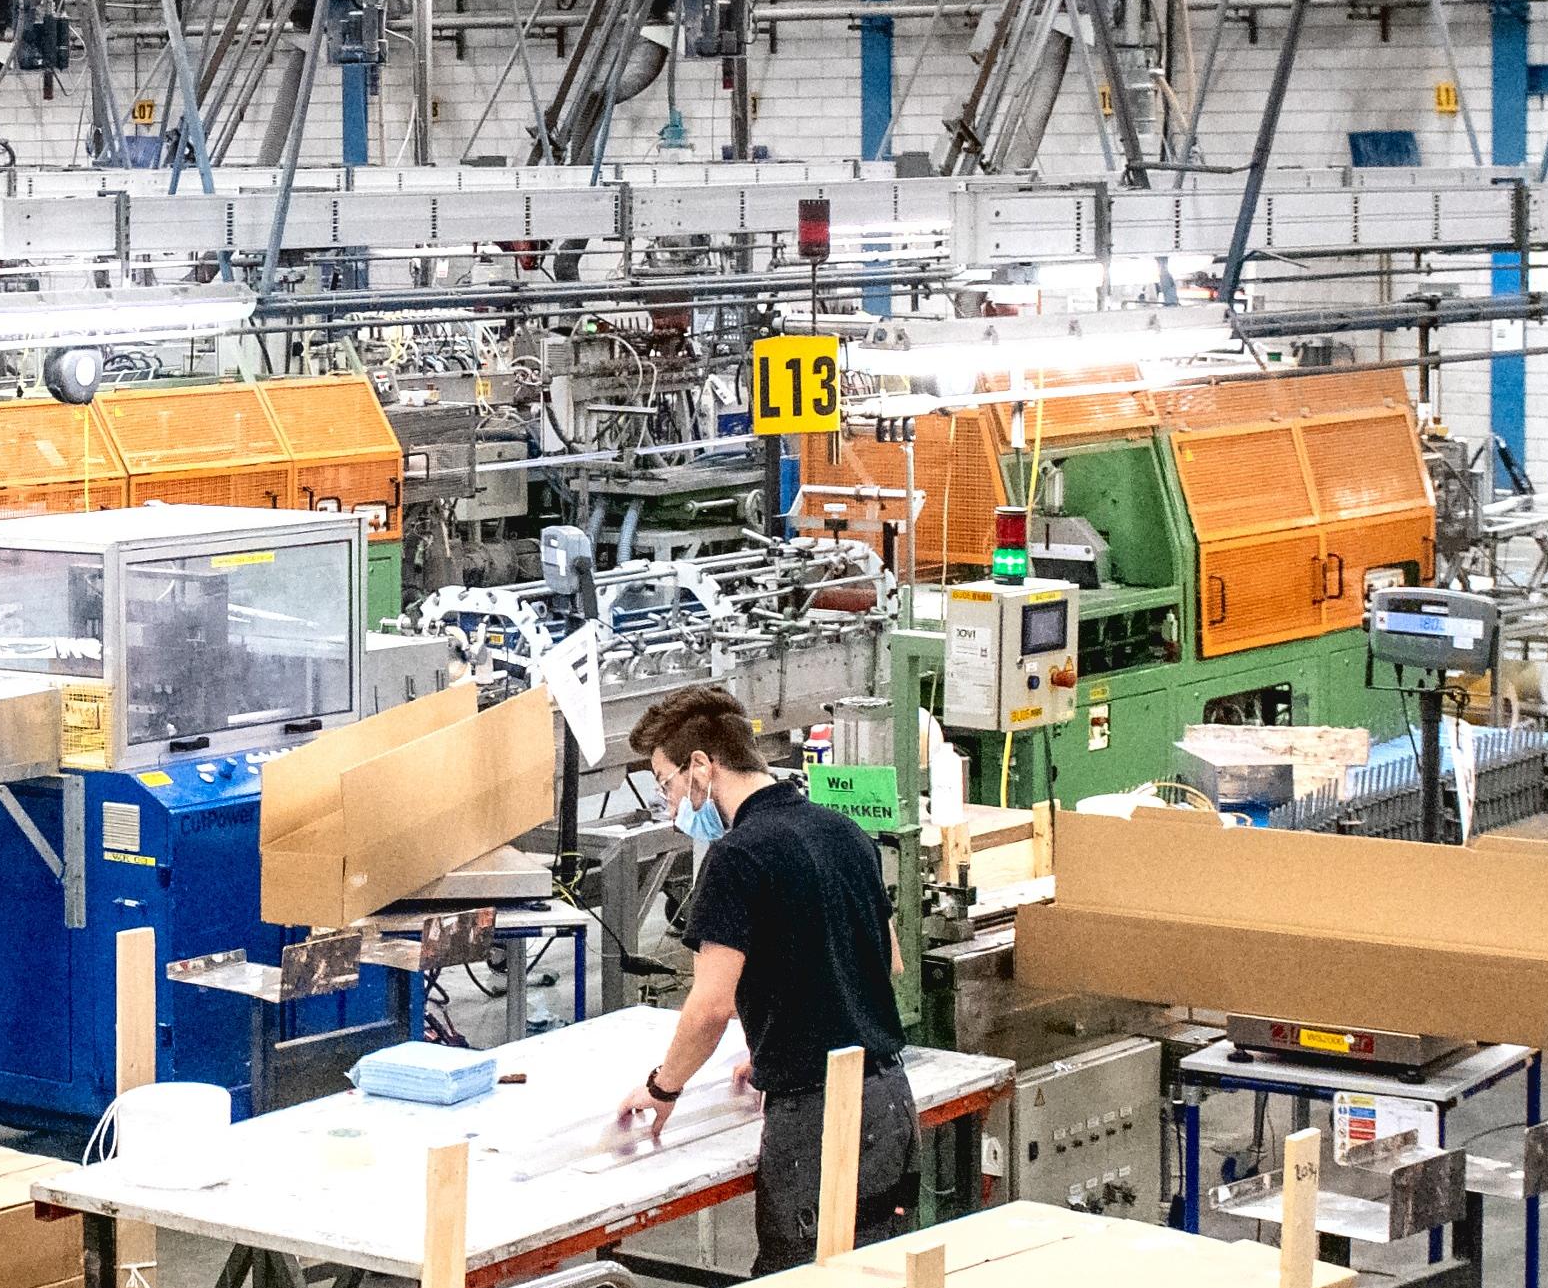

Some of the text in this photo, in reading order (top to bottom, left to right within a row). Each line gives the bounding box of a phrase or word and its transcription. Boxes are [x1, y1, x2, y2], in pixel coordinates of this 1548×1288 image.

[132, 104, 154, 121] L07
[758, 355, 837, 419] L13
[826, 776, 854, 790] Wel
[821, 802, 893, 819] PAKKEN
